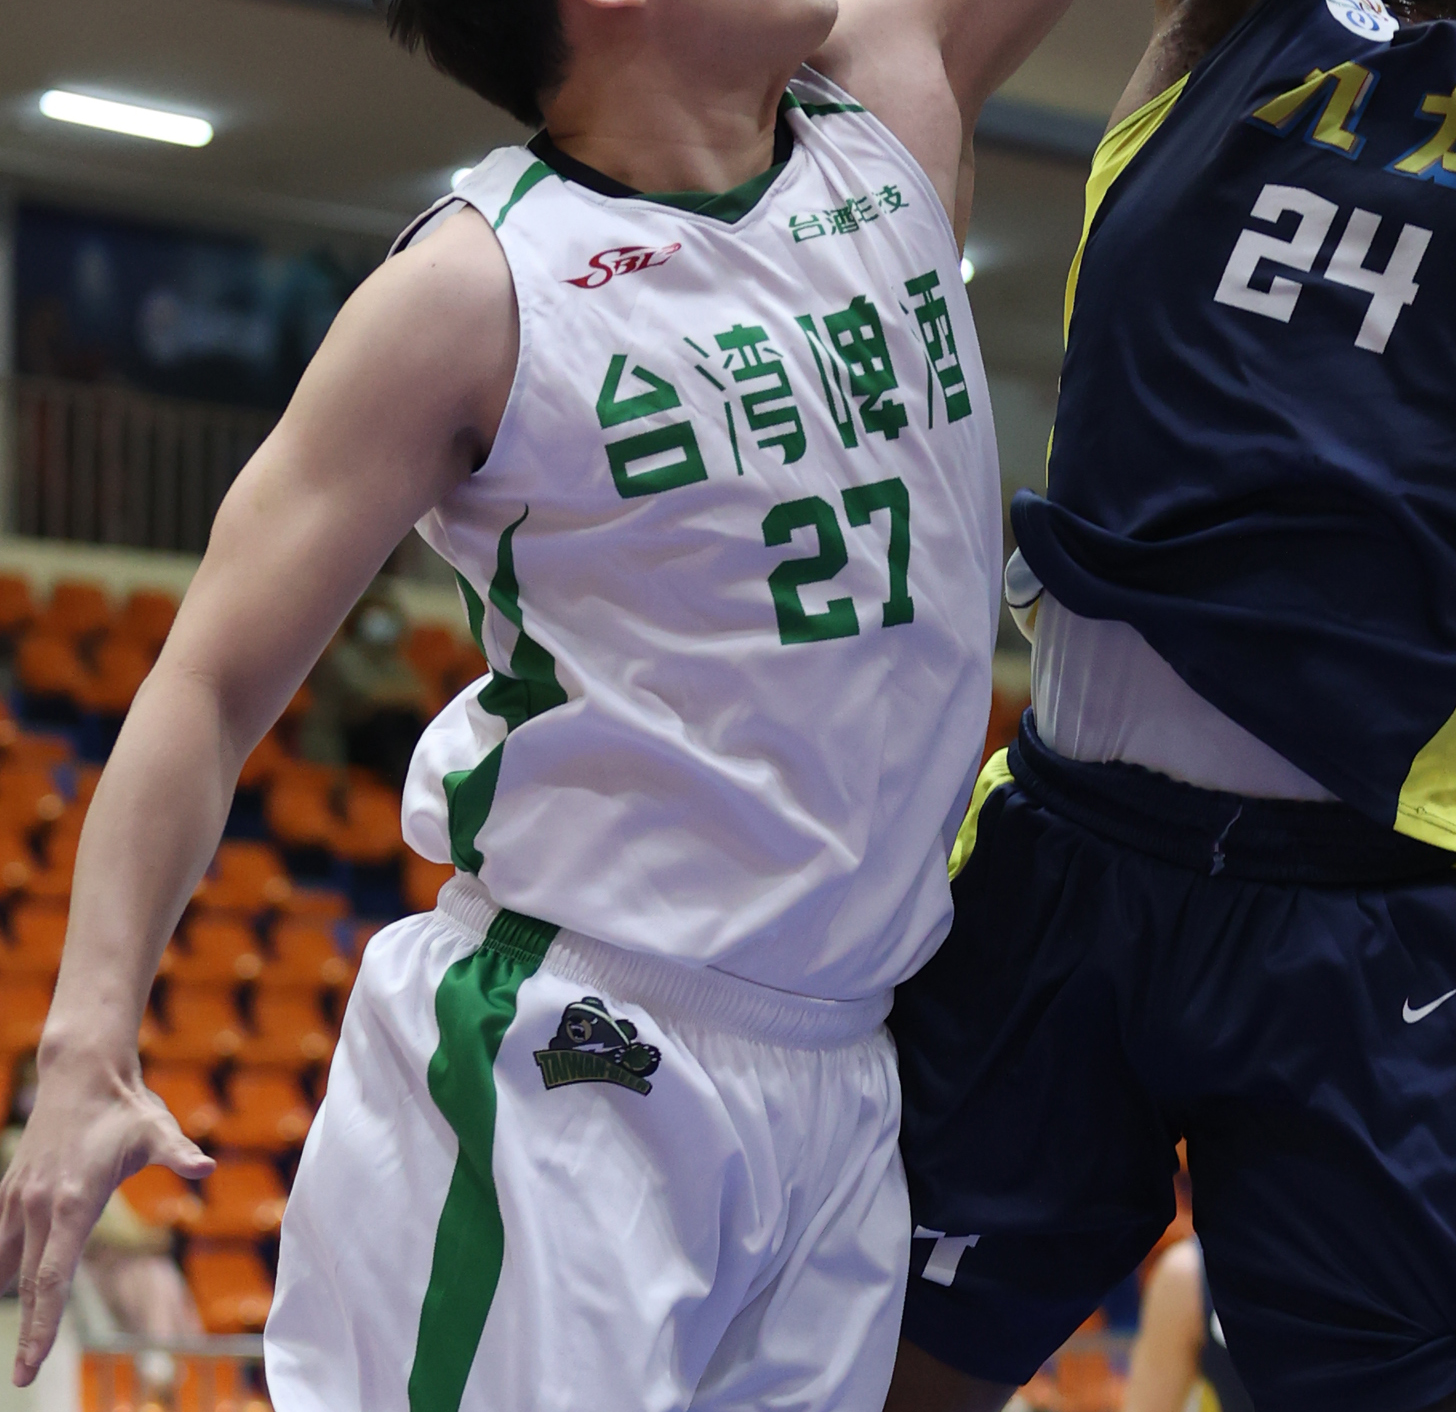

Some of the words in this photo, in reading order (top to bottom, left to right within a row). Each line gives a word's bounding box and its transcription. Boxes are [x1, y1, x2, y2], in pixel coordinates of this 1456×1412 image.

[561, 243, 673, 290] SBL
[1213, 184, 1434, 355] 24
[761, 477, 915, 646] 27
